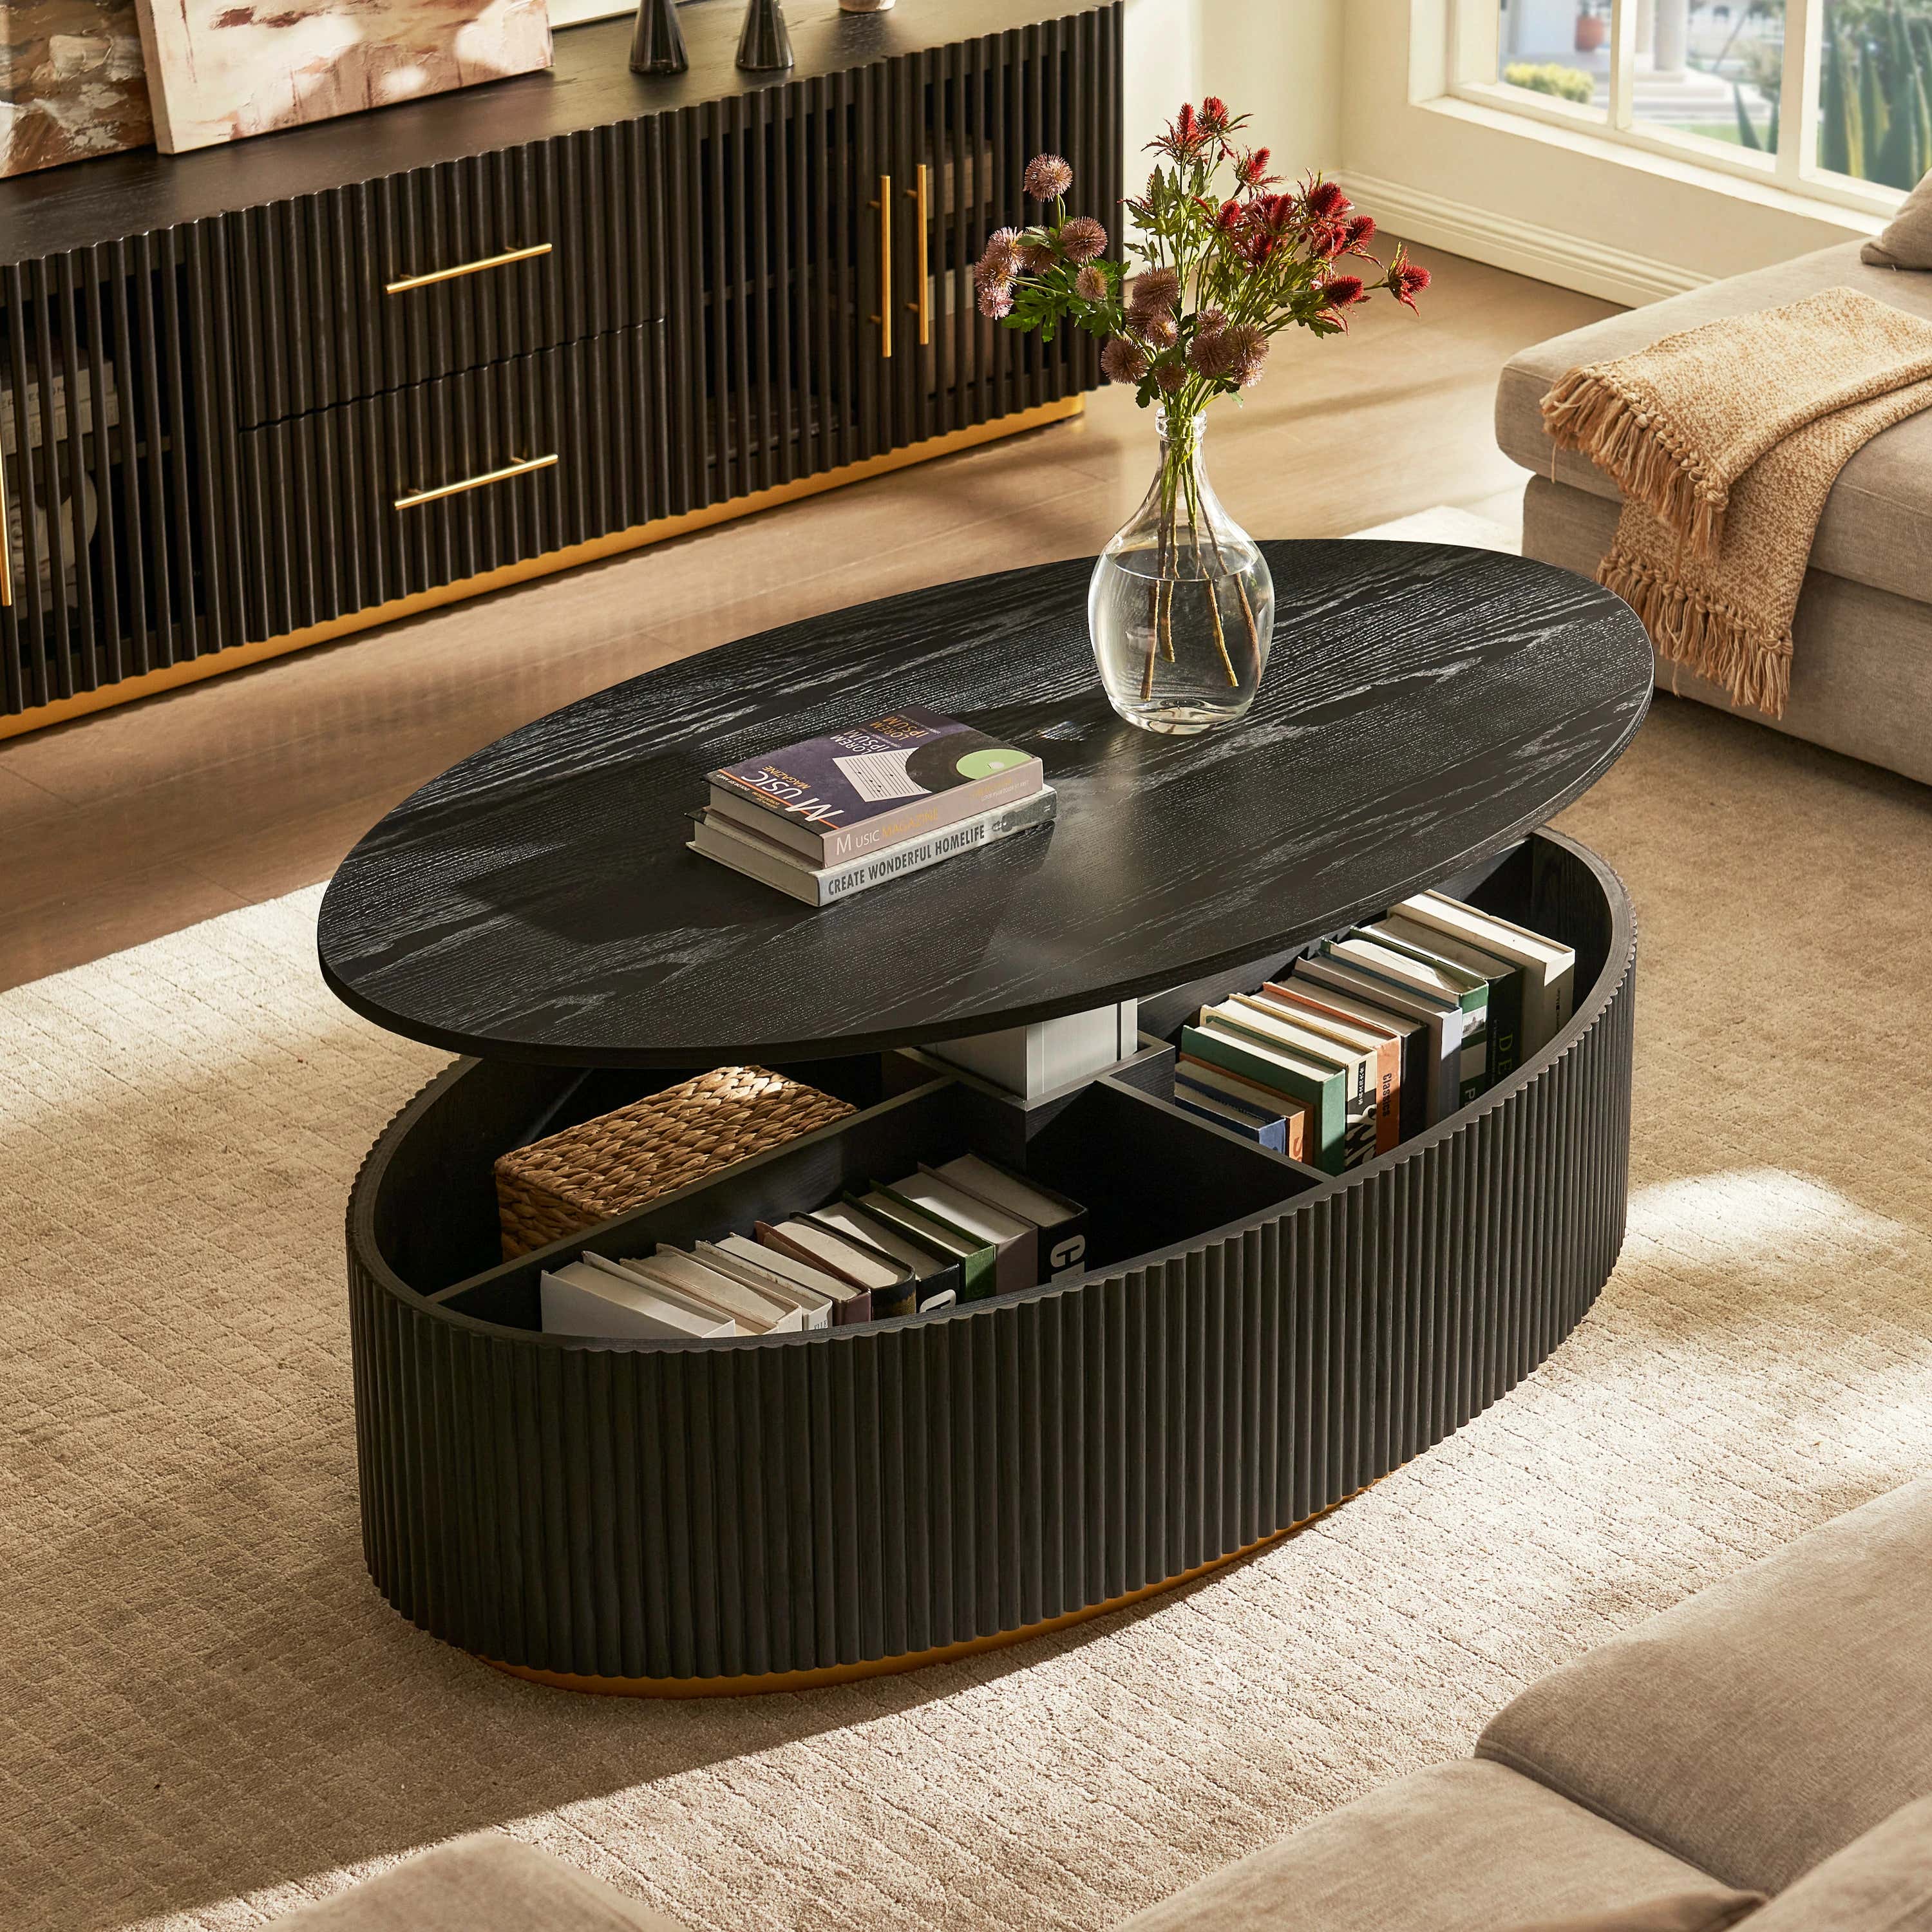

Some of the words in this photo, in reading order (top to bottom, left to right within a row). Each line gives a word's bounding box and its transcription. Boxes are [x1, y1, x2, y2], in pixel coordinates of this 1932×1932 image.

[869, 721, 909, 741] LOREM
[883, 716, 929, 738] IPSUM
[830, 734, 872, 755] LOREM
[844, 730, 890, 752] IPSUM
[762, 765, 811, 790] MAGAZINE
[881, 808, 939, 837] MAGAZINE
[828, 869, 865, 895] CREATE
[868, 844, 931, 880] WONDERFUL
[935, 824, 985, 855] HOMELIFE
[1383, 1072, 1392, 1117] Classics
